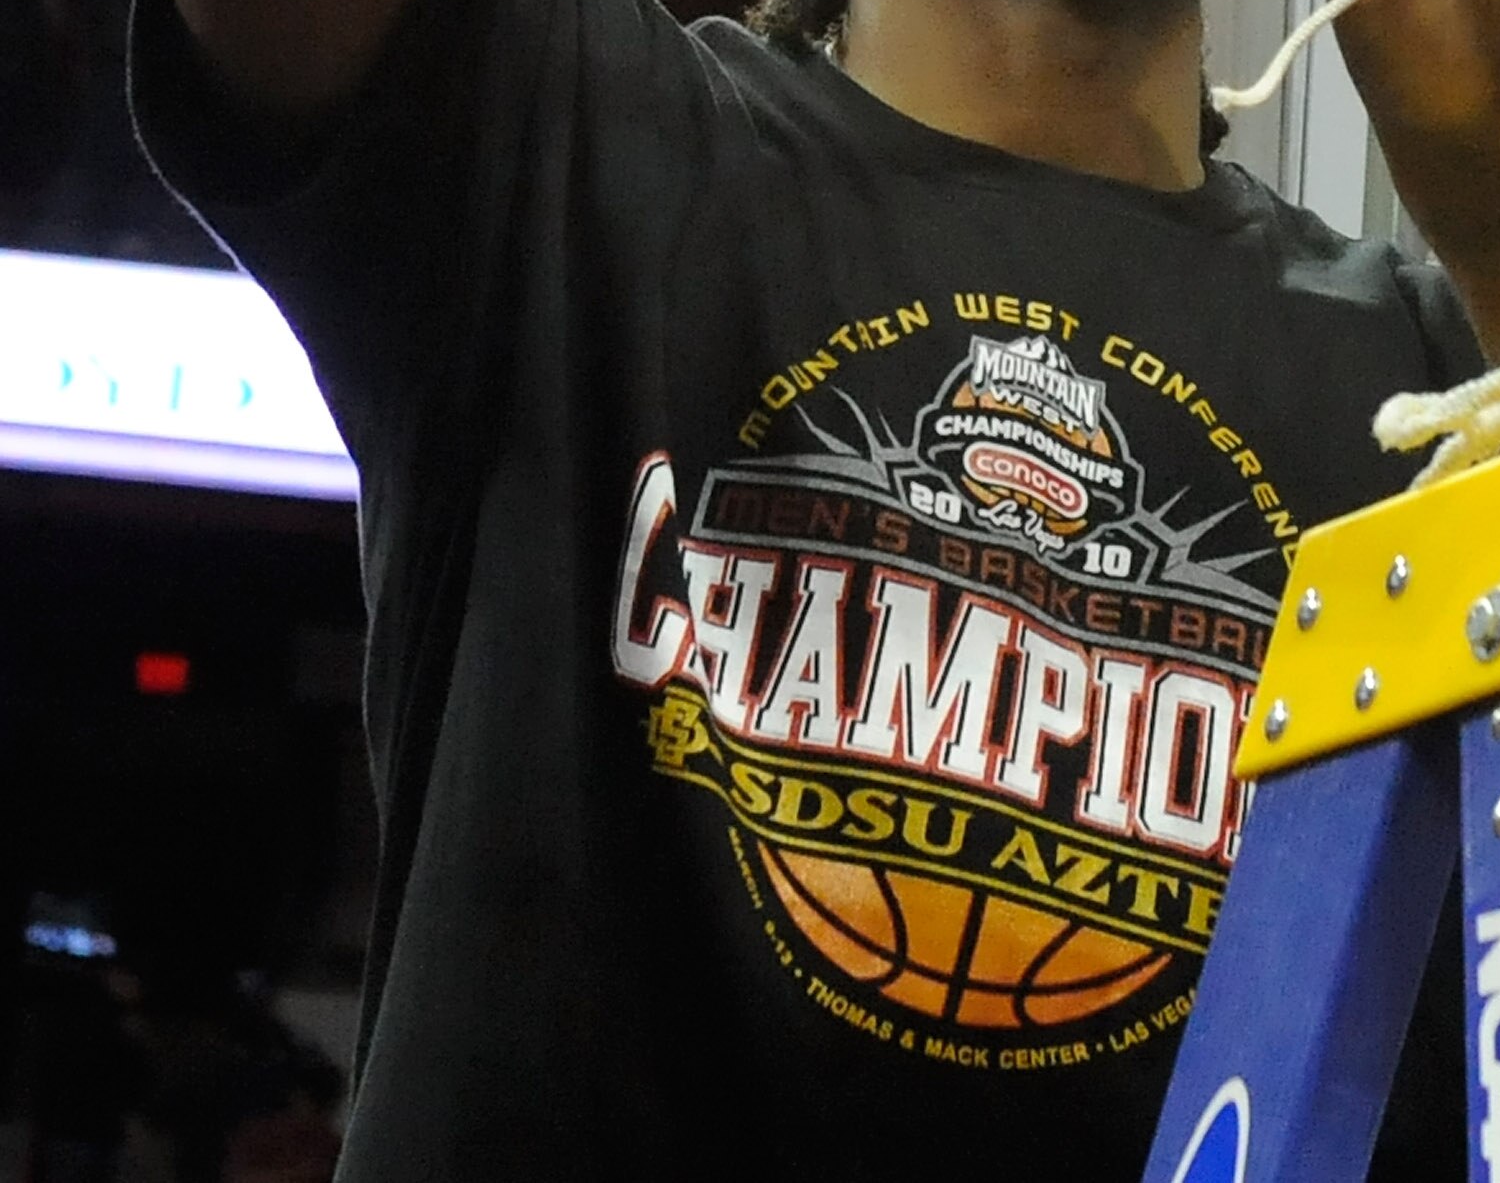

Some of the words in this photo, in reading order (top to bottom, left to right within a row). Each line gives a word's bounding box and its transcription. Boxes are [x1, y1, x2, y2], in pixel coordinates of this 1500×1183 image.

[738, 299, 930, 450] MOUNTAIN
[954, 293, 1080, 341] WEST
[973, 344, 1097, 429] MOUNTAIN
[989, 385, 1081, 433] WEST
[934, 414, 1124, 489] CHAMPIONSHIPS
[909, 480, 962, 524] 20
[1082, 541, 1133, 578] 10
[611, 449, 1262, 866] CHAMPIO
[731, 762, 973, 857] SDSU
[805, 975, 895, 1041] THOMAS
[900, 1028, 915, 1050] &
[924, 1037, 989, 1068] MACK
[999, 1041, 1091, 1070] CENTER
[1108, 1021, 1150, 1053] LAS
